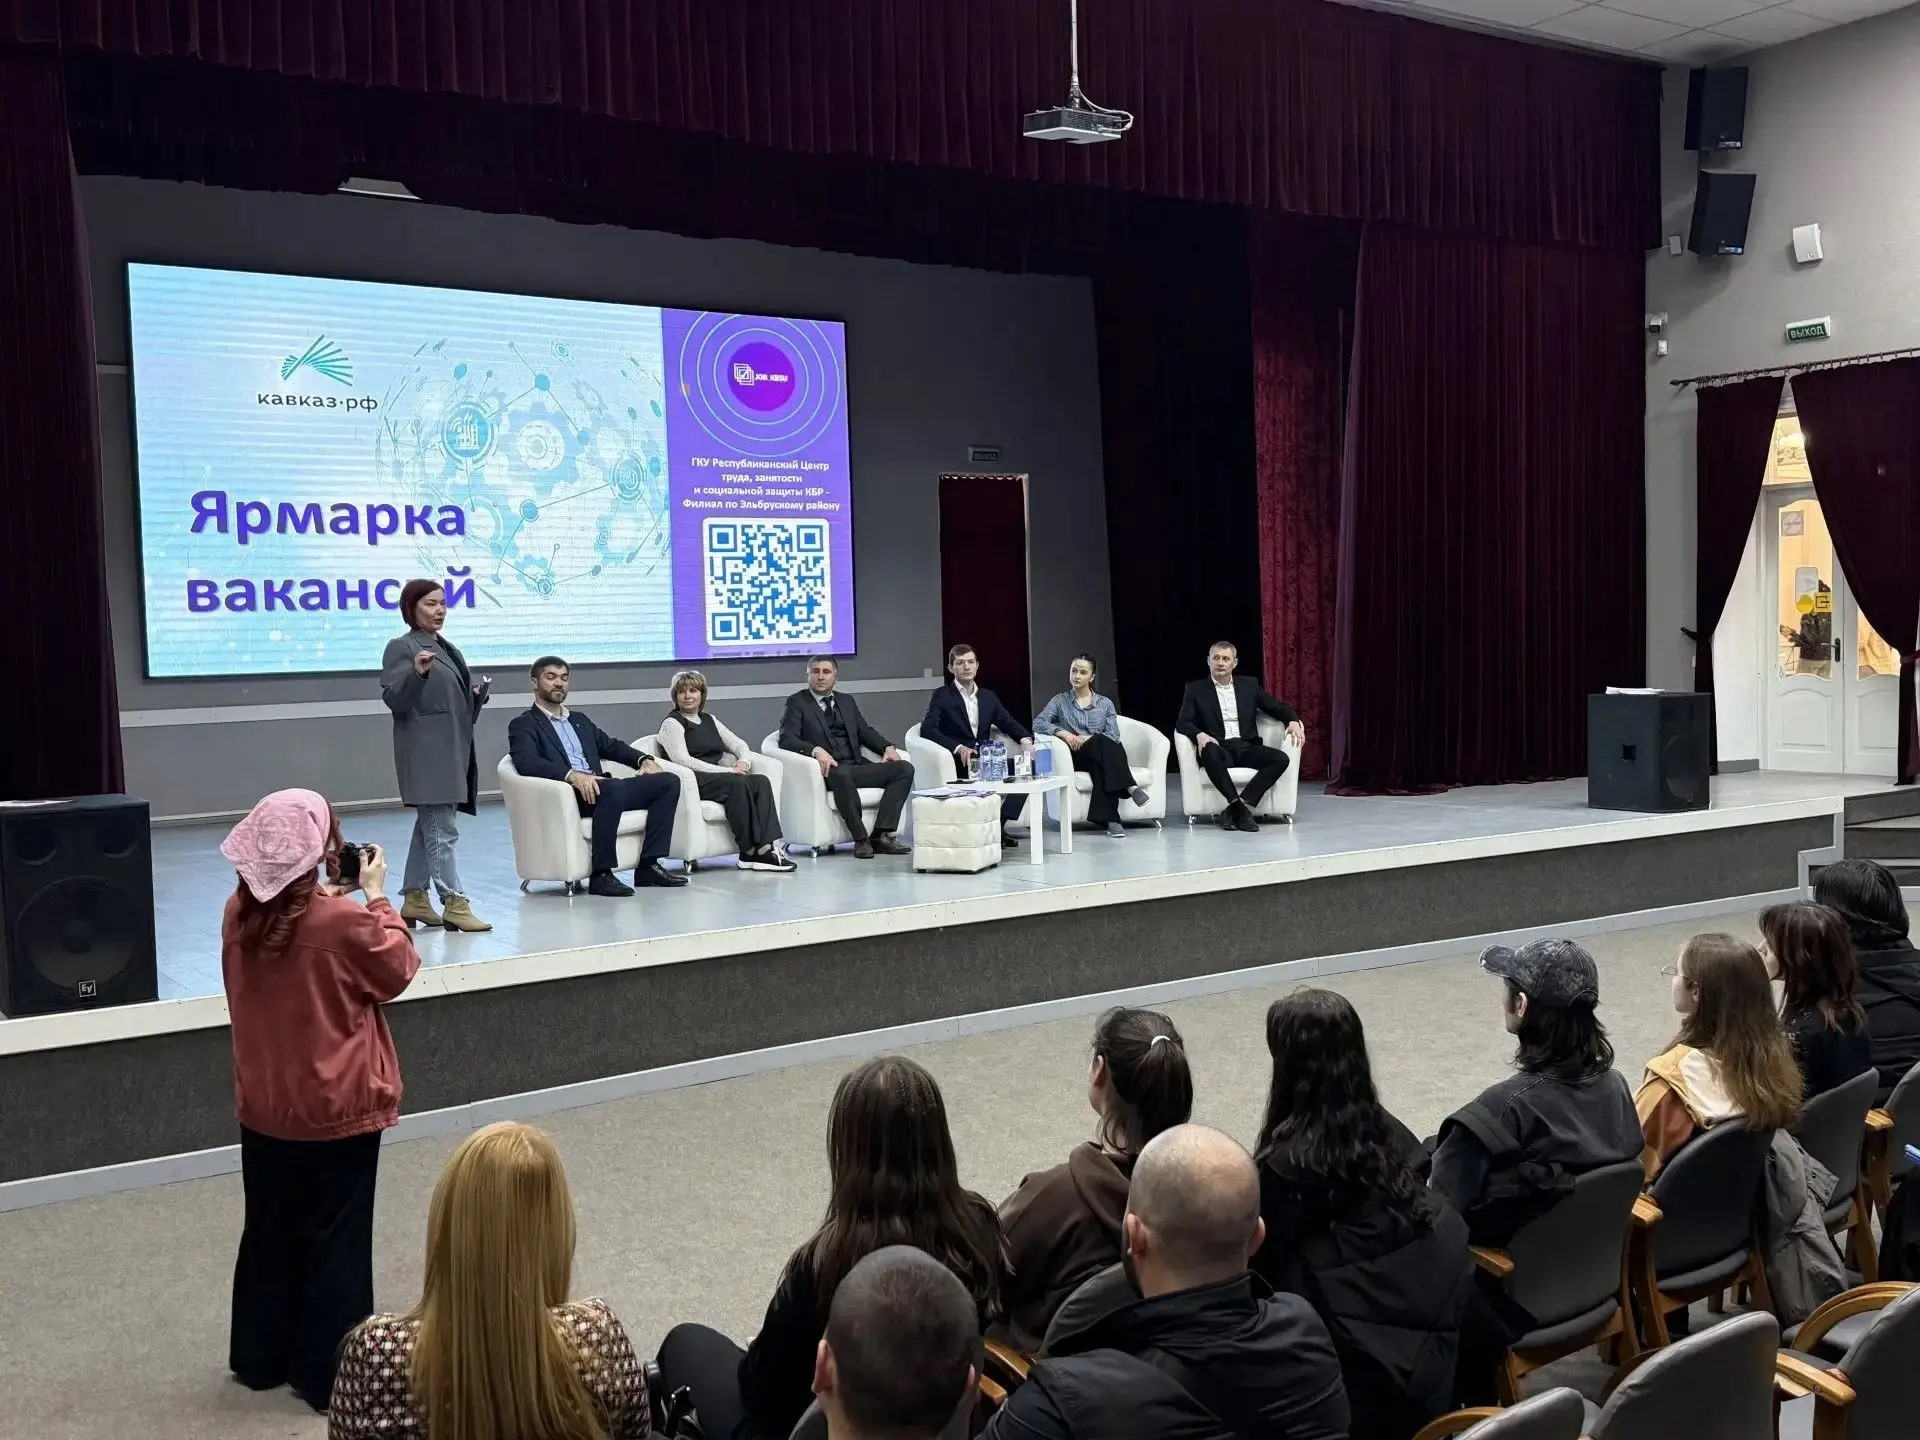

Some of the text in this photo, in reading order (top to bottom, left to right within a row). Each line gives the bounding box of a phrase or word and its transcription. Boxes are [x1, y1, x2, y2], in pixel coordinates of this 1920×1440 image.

[1790, 325, 1825, 339] ВЫХОД
[691, 457, 830, 472] ГКУ Республиканский Центр
[721, 474, 803, 484] труда, занятости
[703, 486, 763, 497] социальной
[765, 488, 803, 498] защиты
[805, 487, 824, 496] КБР
[682, 498, 840, 512] Филиал по Эльбрускому району
[190, 490, 466, 545] Ярмарка
[187, 566, 476, 612] вакансй
